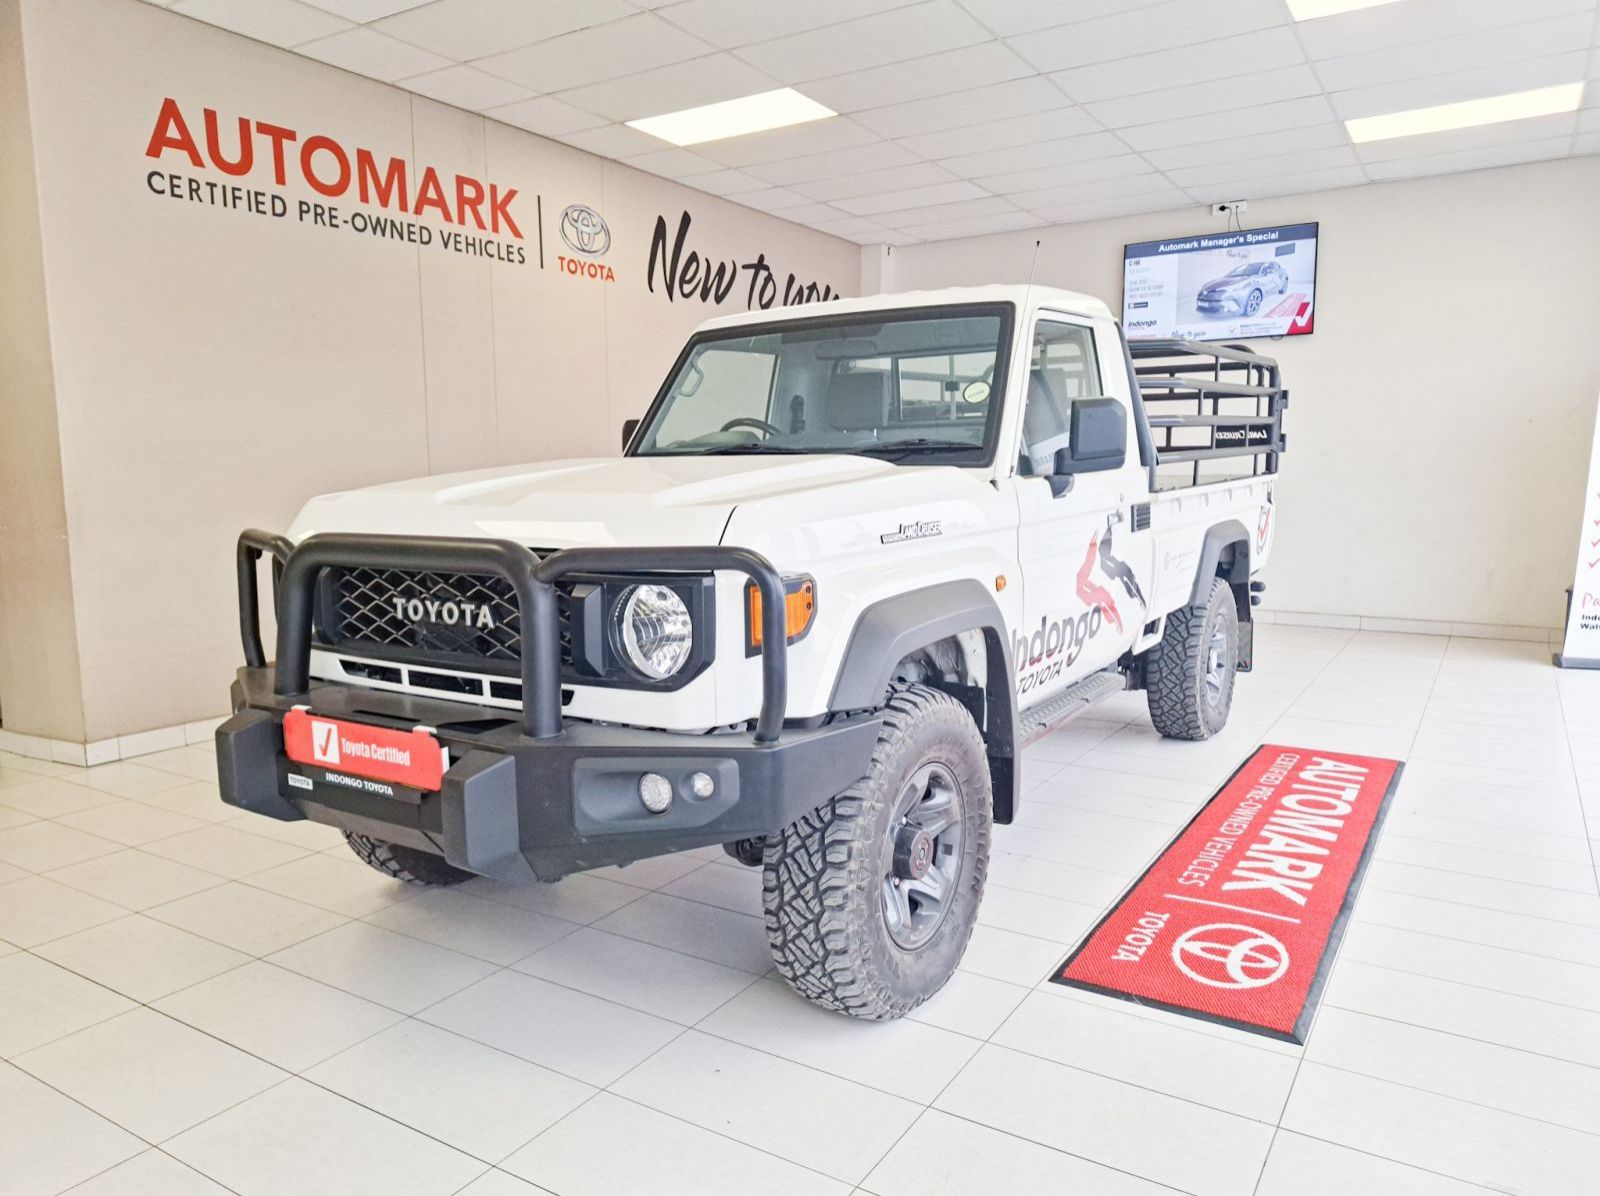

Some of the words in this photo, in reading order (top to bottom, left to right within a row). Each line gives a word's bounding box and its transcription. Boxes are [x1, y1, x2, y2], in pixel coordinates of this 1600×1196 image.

[145, 98, 524, 239] AUTOMARK
[147, 170, 287, 217] CERTIFIED
[298, 200, 432, 245] PRE-OWNED
[440, 230, 525, 264] VEHICLES
[1158, 241, 1198, 253] Automark
[1200, 234, 1244, 248] Manager's
[1246, 231, 1279, 243] Special
[558, 256, 615, 282] TOYOTA
[648, 210, 737, 305] New
[741, 254, 776, 311] to
[1128, 319, 1157, 327] Indongo
[392, 597, 494, 629] TOYOTA
[1012, 605, 1102, 672] Indongo
[1016, 659, 1064, 694] TOYOTA
[341, 737, 371, 757] Toyota
[371, 743, 410, 767] Certified
[1259, 753, 1300, 785] CERTIFIED
[289, 775, 311, 787] TOYOTA
[325, 772, 362, 788] INDONGO
[364, 780, 394, 795] TOYOTA
[1219, 785, 1276, 835] PRE-OWNED
[1221, 756, 1369, 906] AUTOMARK
[1177, 836, 1237, 887] VEHICLES
[1111, 910, 1171, 961] TOYOTA
